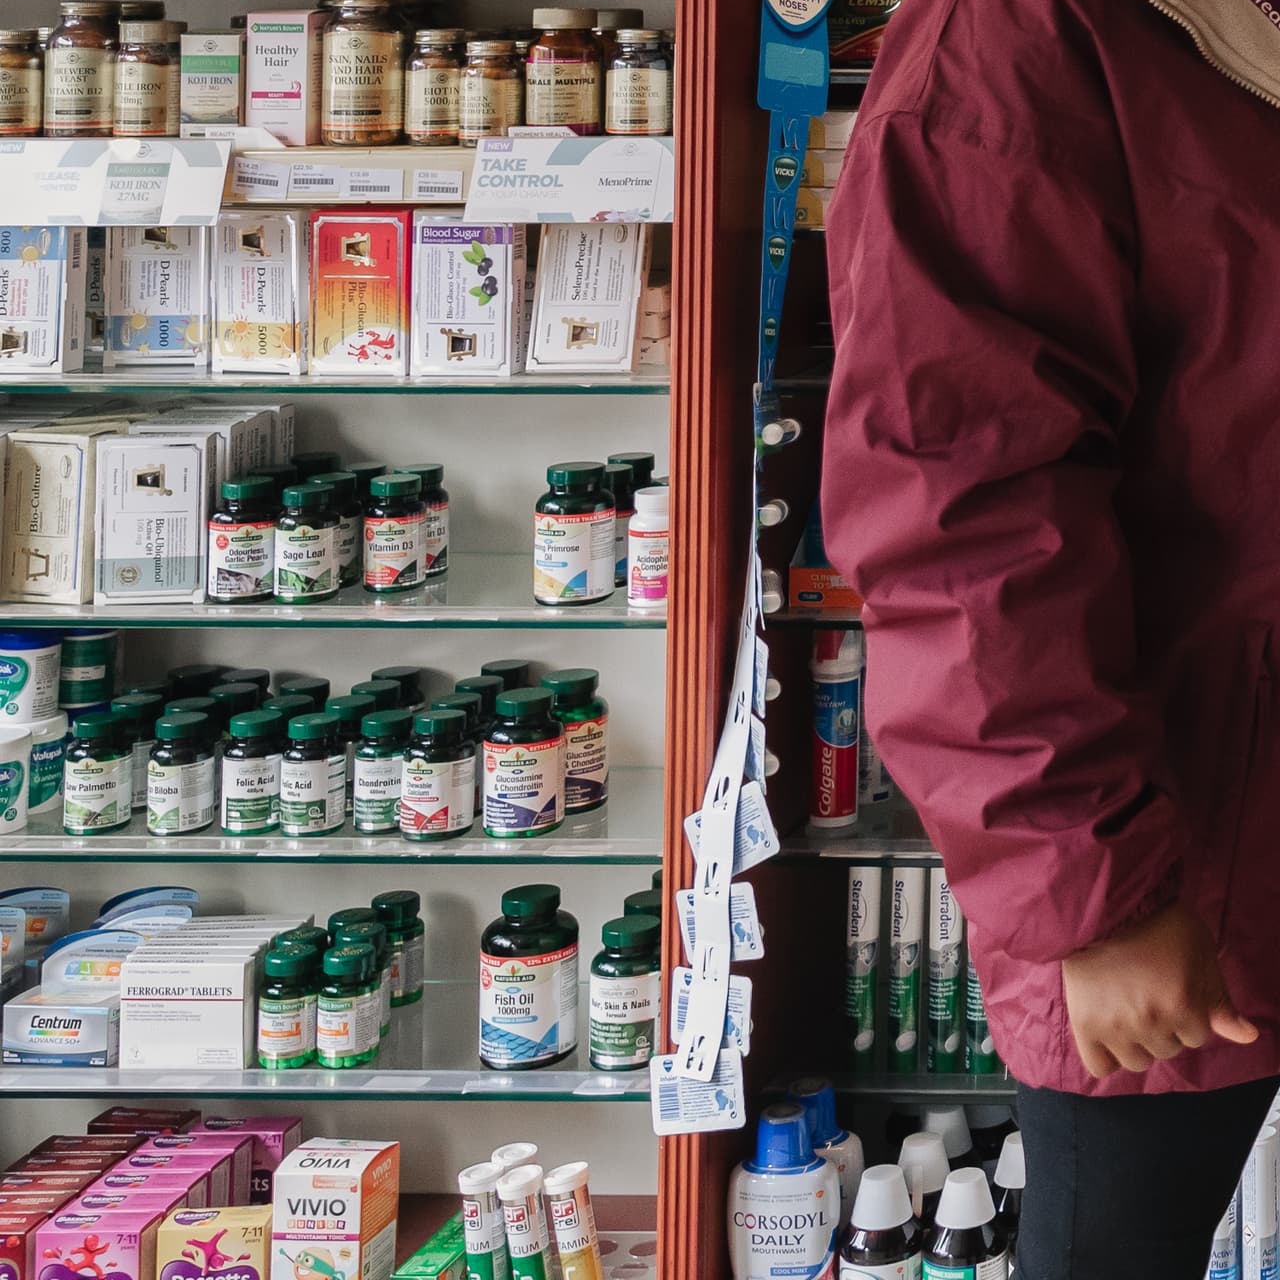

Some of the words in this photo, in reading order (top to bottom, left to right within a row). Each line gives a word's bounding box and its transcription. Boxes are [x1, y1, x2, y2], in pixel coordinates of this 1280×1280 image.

[779, 0, 808, 12] NOSES
[255, 45, 299, 58] Healthy
[264, 56, 289, 68] Hair
[480, 158, 527, 171] TAKE
[477, 174, 563, 188] CONTROL
[423, 228, 451, 238] Blood
[453, 228, 481, 239] Sugar
[159, 320, 169, 347] 1000
[257, 325, 267, 355] 5000
[820, 747, 836, 815] Colgate
[851, 880, 862, 937] Steradent
[893, 880, 904, 938] Steradent
[939, 883, 950, 940] Steradent
[495, 994, 516, 1006] Fish
[519, 994, 534, 1005] Oil
[497, 1006, 531, 1016] 1000mg
[30, 1015, 82, 1029] Centrum
[287, 1198, 346, 1216] VIVIO
[734, 1211, 827, 1230] CORSODYL
[242, 1227, 263, 1237] 7-11
[117, 1234, 137, 1244] 7-11
[752, 1234, 805, 1246] DAILY
